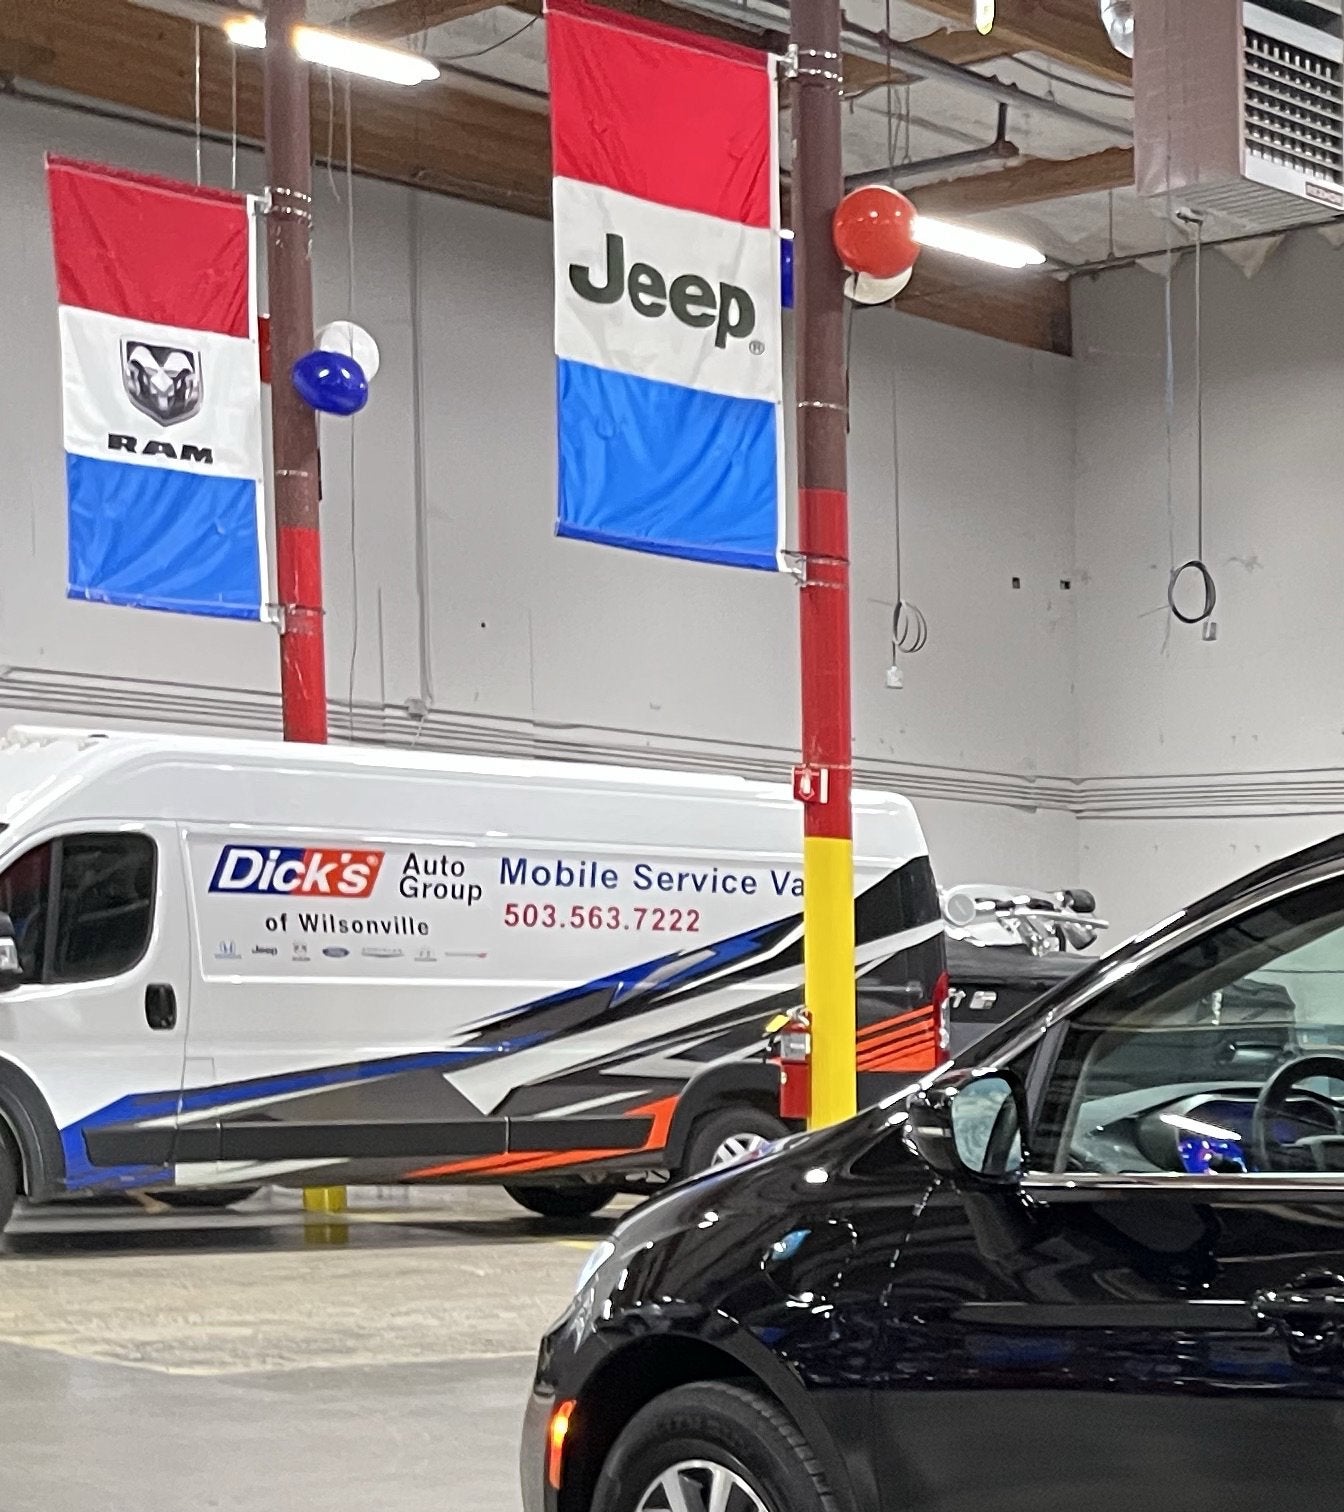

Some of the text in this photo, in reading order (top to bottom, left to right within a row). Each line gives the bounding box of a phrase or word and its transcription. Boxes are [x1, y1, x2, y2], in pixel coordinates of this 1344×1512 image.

[569, 233, 756, 349] Jeep
[108, 433, 213, 465] RAM
[217, 848, 372, 895] Dick's
[402, 852, 465, 878] Auto
[499, 856, 620, 890] Mobile
[632, 863, 758, 895] Service
[399, 875, 483, 906] Group
[265, 912, 430, 936] of Wilsonville
[503, 902, 701, 933] 503.563.7222
